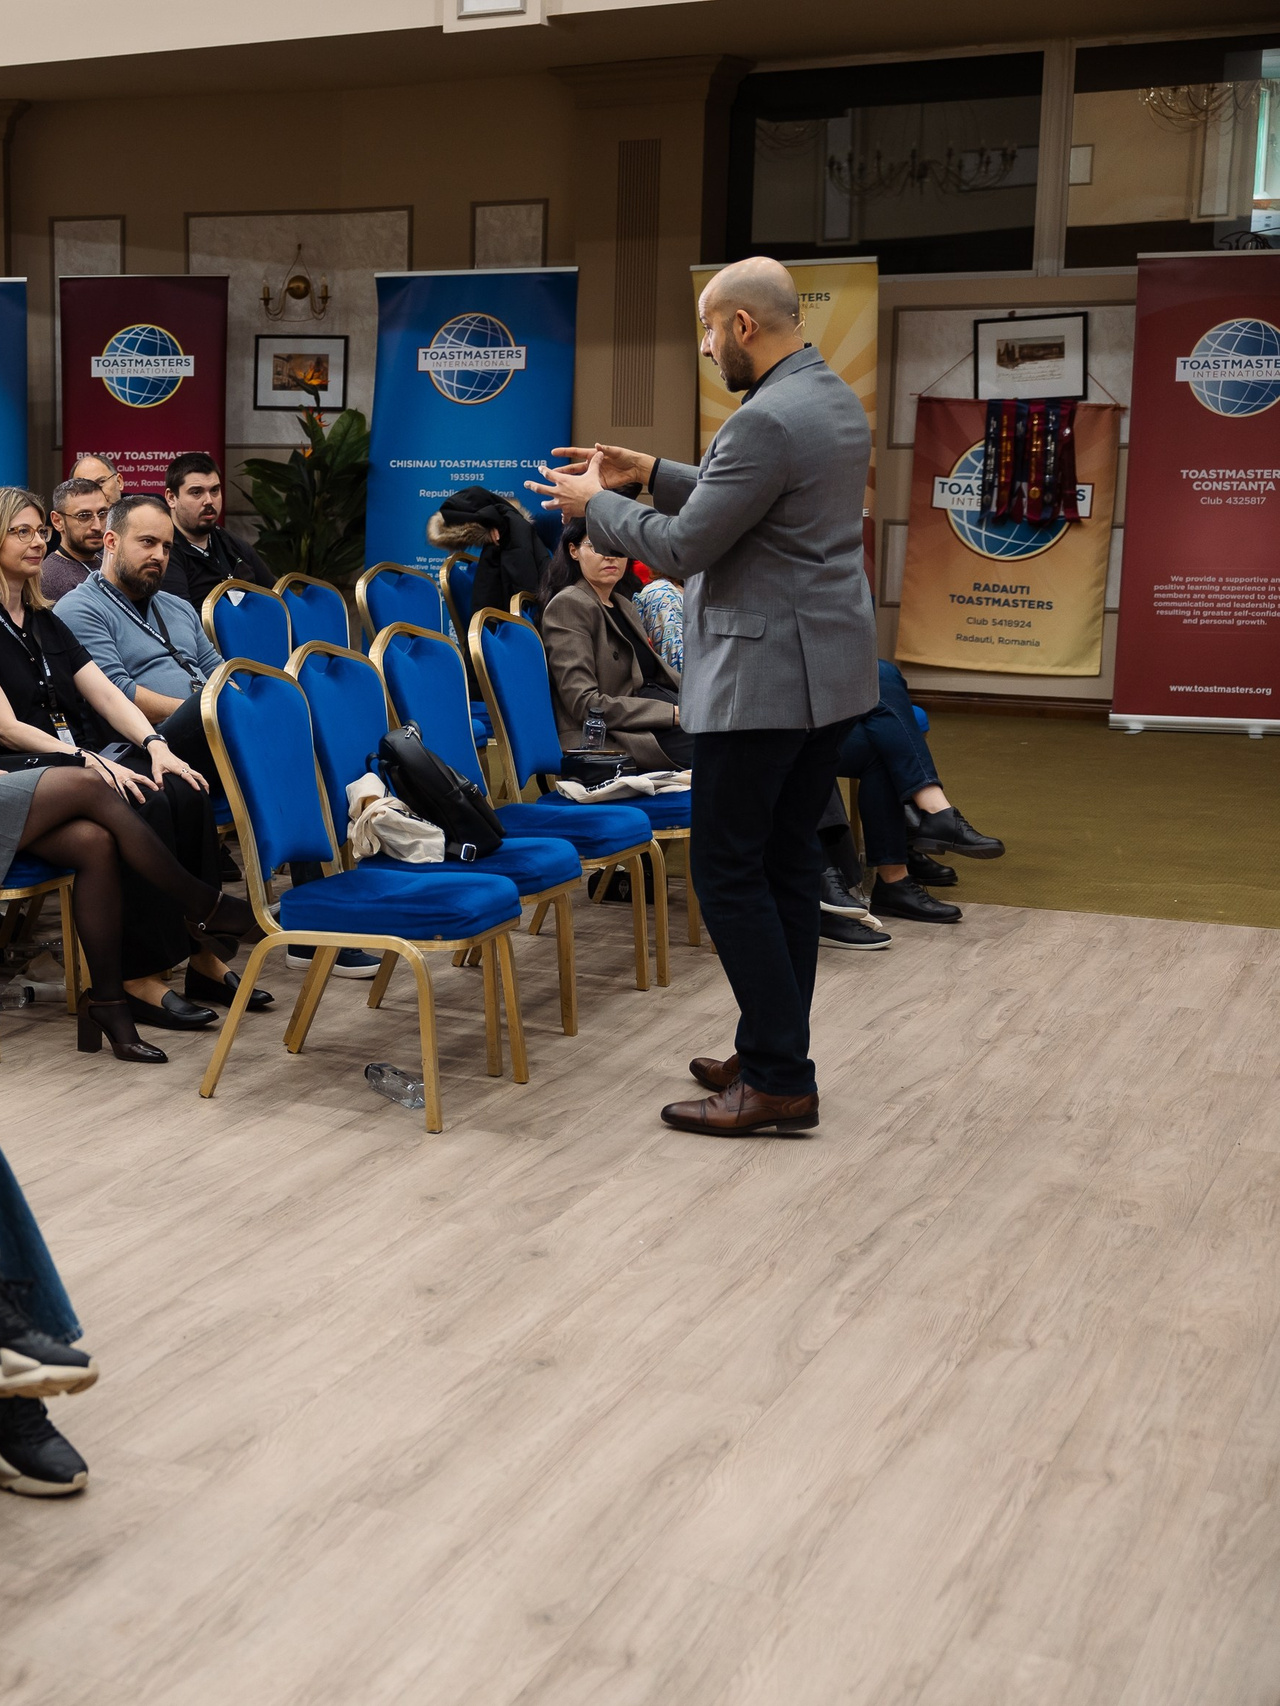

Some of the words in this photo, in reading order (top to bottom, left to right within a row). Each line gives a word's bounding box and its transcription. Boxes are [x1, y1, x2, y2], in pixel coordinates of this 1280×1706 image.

[422, 349, 522, 360] TOASTMASTERS
[94, 358, 191, 368] TOASTMASTERS
[432, 360, 511, 368] INTERNATIONAL
[1180, 359, 1280, 370] TOASTMASTE
[104, 367, 181, 375] INTERNATIONAL
[1192, 370, 1280, 378] INTERNATIONA
[389, 460, 437, 468] CHISINAU
[439, 460, 518, 468] TOASTMASTERS
[520, 460, 548, 468] CLUB
[117, 465, 135, 473] Club
[450, 473, 485, 481] 1935913
[1180, 469, 1280, 479] TOASTMASTER
[1200, 497, 1223, 505] Club
[1225, 497, 1266, 505] 4325817
[1185, 575, 1216, 583] provide
[973, 582, 1030, 595] RADAUTI
[1187, 584, 1220, 592] learning
[949, 594, 1053, 610] TOASTMASTERS
[1233, 601, 1275, 609] leadership
[966, 616, 988, 626] Club
[1200, 617, 1234, 625] personal
[1236, 618, 1267, 626] growth.
[955, 633, 995, 645] Radauti,
[998, 636, 1040, 647] Romania
[1169, 685, 1272, 696] www.toastmasters.org
